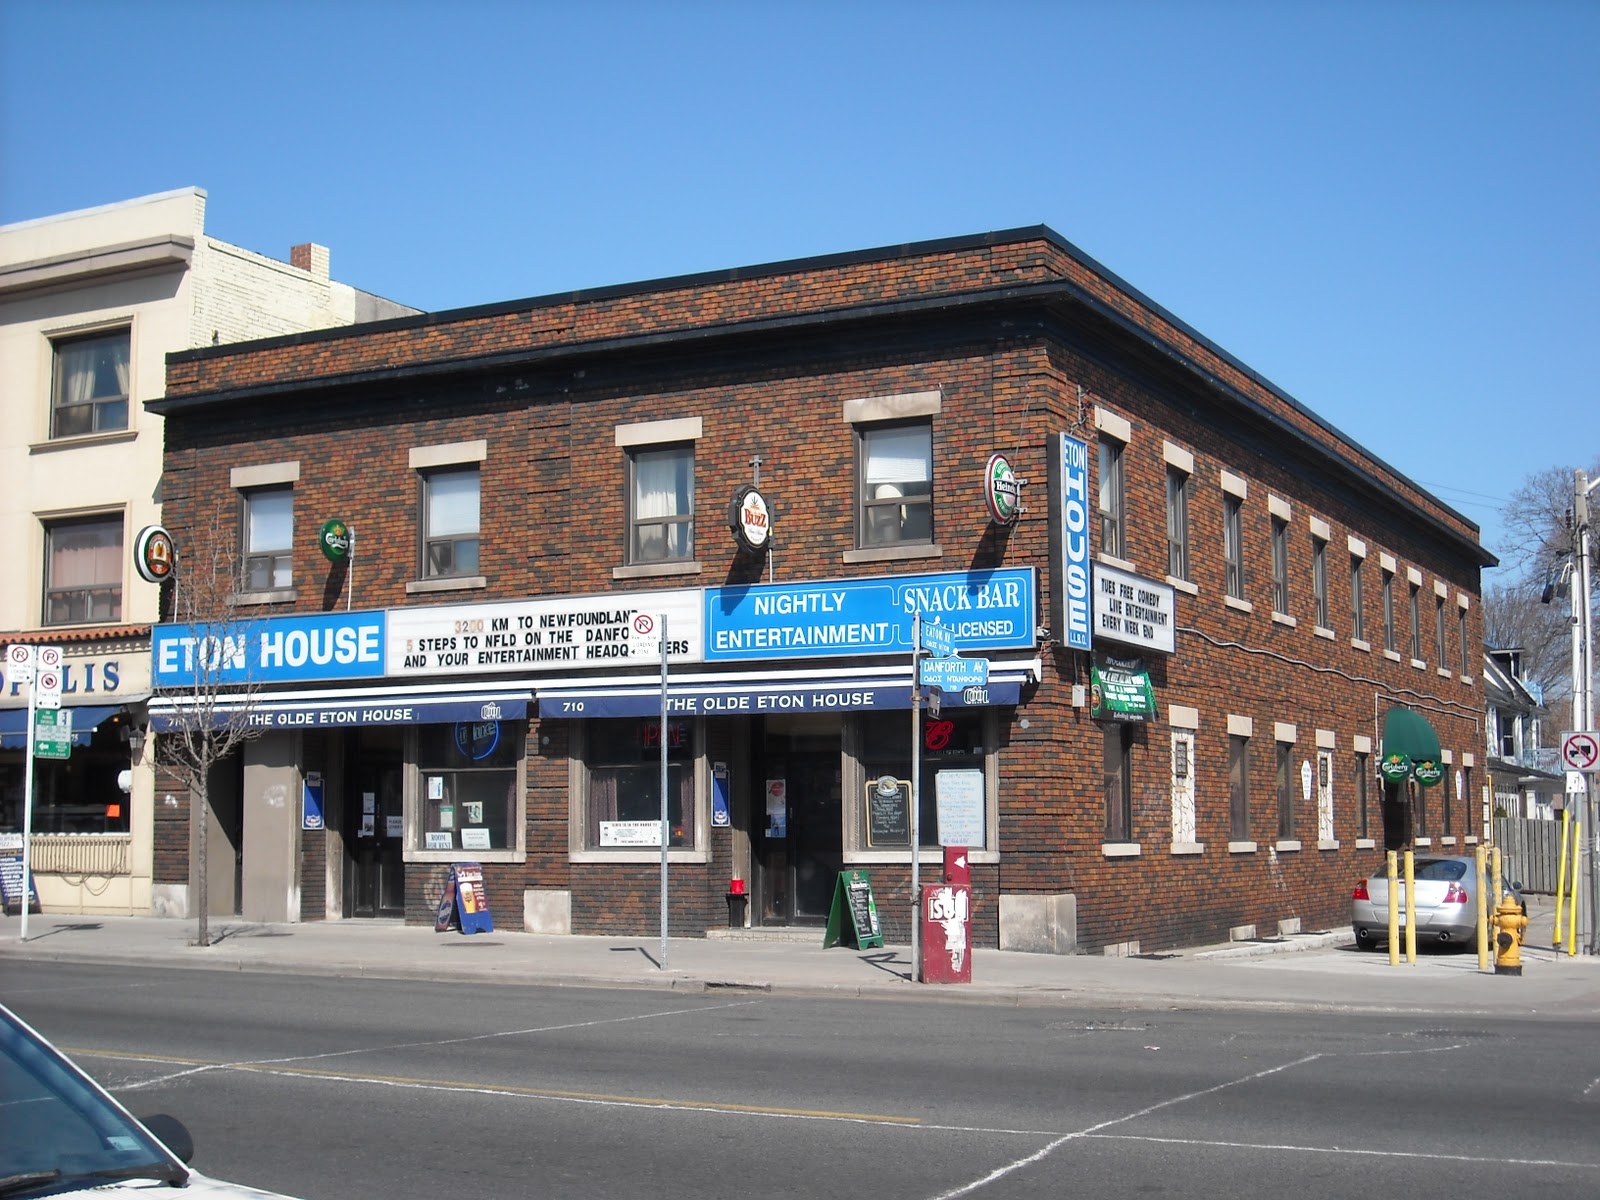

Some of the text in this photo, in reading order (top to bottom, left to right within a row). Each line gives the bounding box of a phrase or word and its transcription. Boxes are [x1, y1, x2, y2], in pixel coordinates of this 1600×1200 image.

[1065, 440, 1085, 470] ETON
[1065, 466, 1087, 633] HOUSE
[754, 592, 846, 616] NIGHTLY
[904, 582, 1020, 614] SNACK BAR
[1101, 578, 1160, 608] TUES FREE COMEDY
[491, 618, 509, 631] KM
[518, 616, 534, 629] TO
[540, 609, 638, 628] NEWFOUNDLAN
[1109, 598, 1168, 626] LIVE ENTERTAINMENT
[716, 622, 889, 649] ENTERTAINMENT
[1102, 613, 1154, 639] EVERY WEEK END
[158, 625, 380, 673] ETON HOUSE
[419, 638, 456, 651] STEPS
[463, 637, 478, 649] TO
[485, 634, 517, 648] NFLD
[525, 632, 542, 645] ON
[549, 630, 573, 644] THE
[585, 626, 629, 642] DANFO
[404, 655, 427, 668] AND
[437, 653, 468, 666] YOUR
[478, 646, 579, 664] ENTERTAINMENT
[924, 661, 967, 673] DANFORTH
[563, 702, 584, 712] 710
[666, 692, 874, 712] THE OLDE ETON HOUSE
[249, 708, 413, 726] THE OLDE ETON HOUSE
[1382, 762, 1408, 773] Carlsberg
[1415, 767, 1441, 777] Carlsberg
